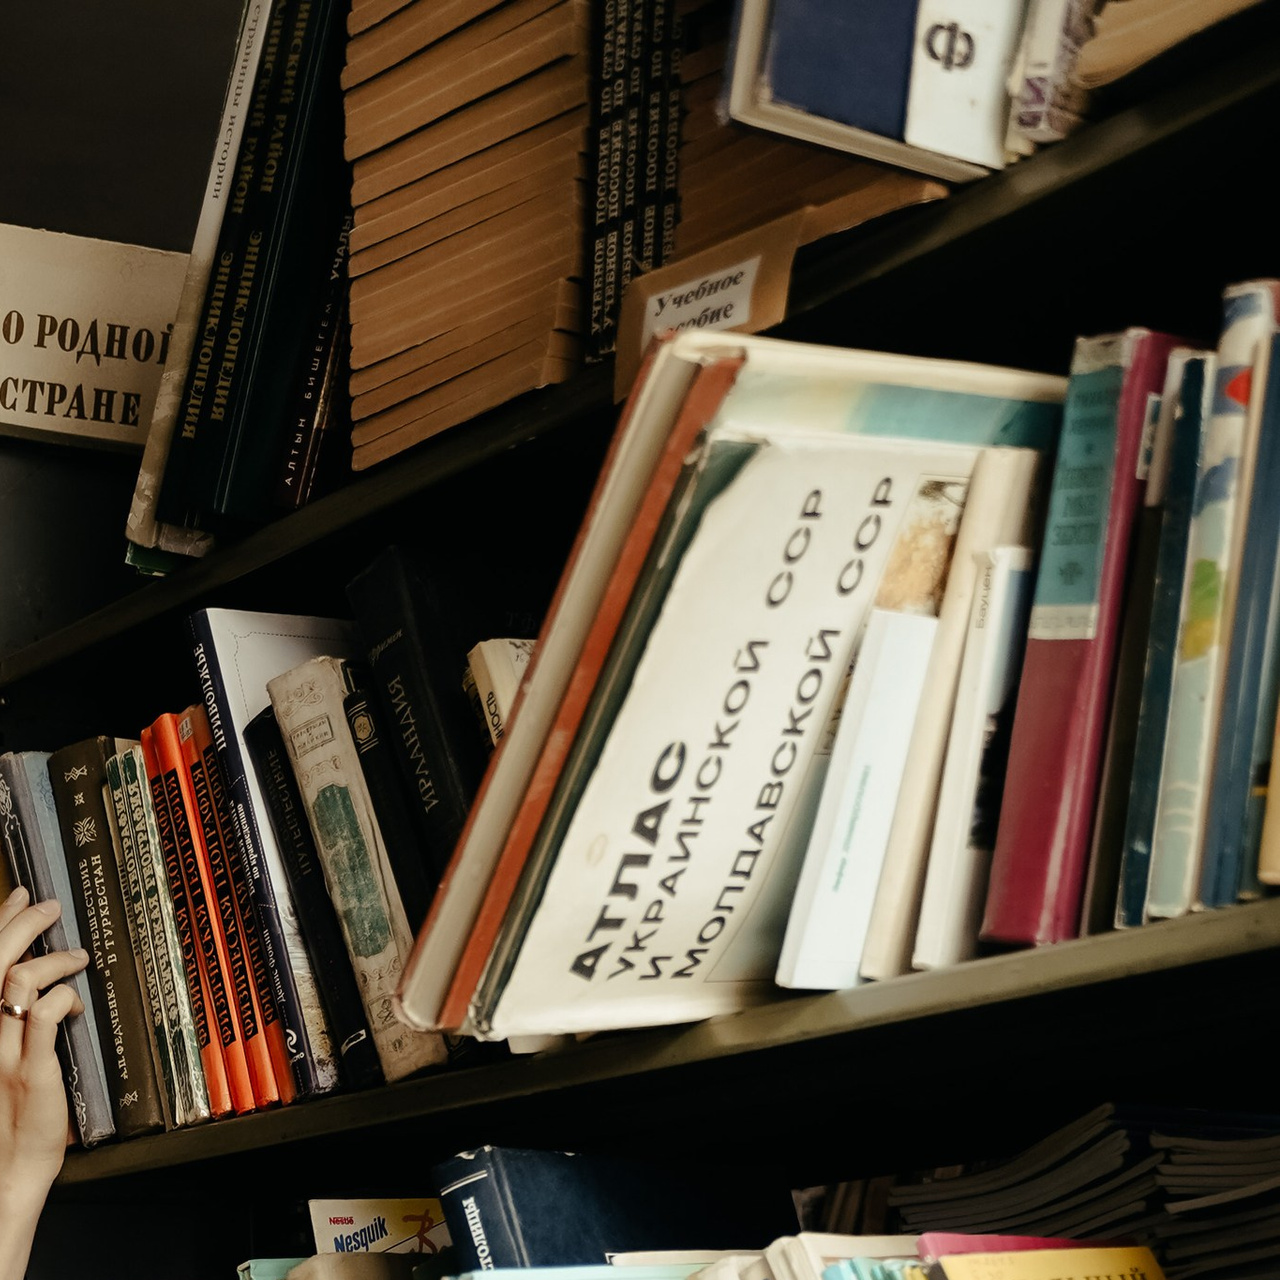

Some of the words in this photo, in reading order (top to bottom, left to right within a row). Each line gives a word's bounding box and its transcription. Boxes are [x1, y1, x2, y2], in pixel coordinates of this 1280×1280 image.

[924, 21, 976, 73] Ф
[624, 106, 639, 208] ПОСОБИЕ
[646, 90, 661, 192] ПОСОБИЕ
[181, 251, 234, 440] ЭНЦИКЛОПЕДИЯ
[210, 230, 263, 422] ЭНЦИКЛОПЕДИЯ
[653, 268, 747, 318] Учебное
[193, 641, 226, 751] ПРИВОЛЖЬЕ
[388, 672, 439, 814] ИРЛАНДИЯ
[608, 637, 771, 982] УКРАИНСКОЙ
[765, 487, 825, 610] ССР
[669, 628, 843, 980] МОЛДАВСКОЙ
[835, 475, 894, 598] ССР
[155, 773, 182, 901] ГЕОГРАФИЯ
[169, 768, 200, 898] ГЕОГРАФИЯ
[568, 741, 688, 983] АТЛАС
[80, 857, 103, 969] ПУТЕШЕСТВИЕ
[92, 853, 114, 949] ТУРКЕСТАН
[106, 952, 118, 964] В
[177, 906, 206, 1046] ФИЗИЧЕСКАЯ
[198, 903, 230, 1043] ФИЗИЧЕСКАЯ
[636, 954, 674, 982] И
[333, 1216, 390, 1254] Nesquik
[462, 1195, 494, 1272] СТОЛИЦЫ
